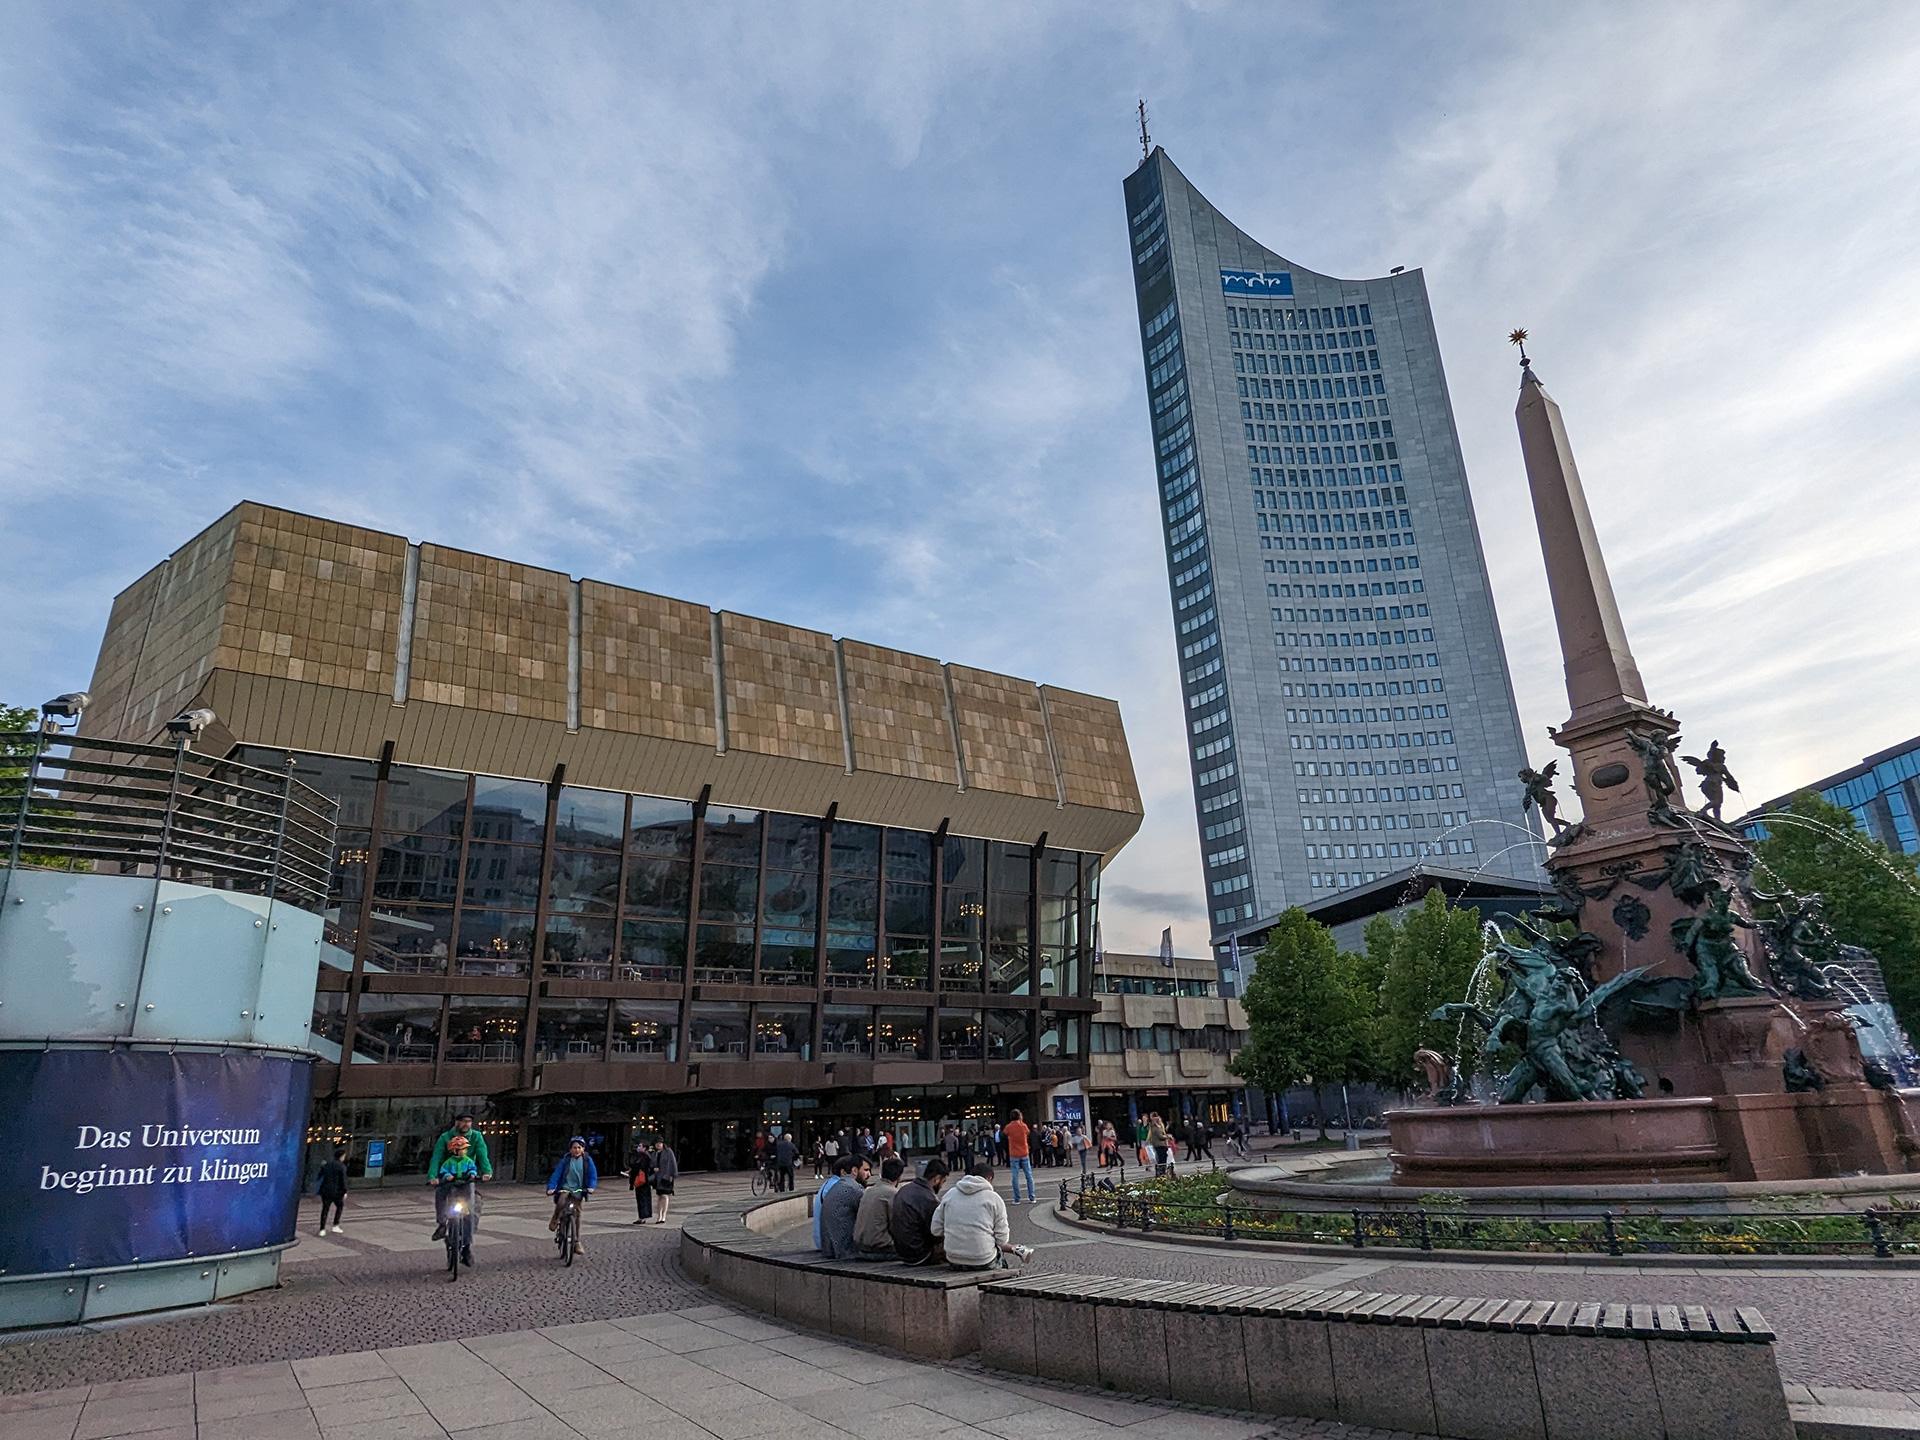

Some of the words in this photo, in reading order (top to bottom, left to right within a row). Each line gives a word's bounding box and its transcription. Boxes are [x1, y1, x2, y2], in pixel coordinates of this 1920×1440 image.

[1222, 272, 1281, 288] mdr
[74, 1125, 131, 1149] Das
[142, 1124, 260, 1147] Universum
[40, 1163, 156, 1194] beginnt
[161, 1165, 193, 1184] zu
[199, 1158, 268, 1184] klingen
